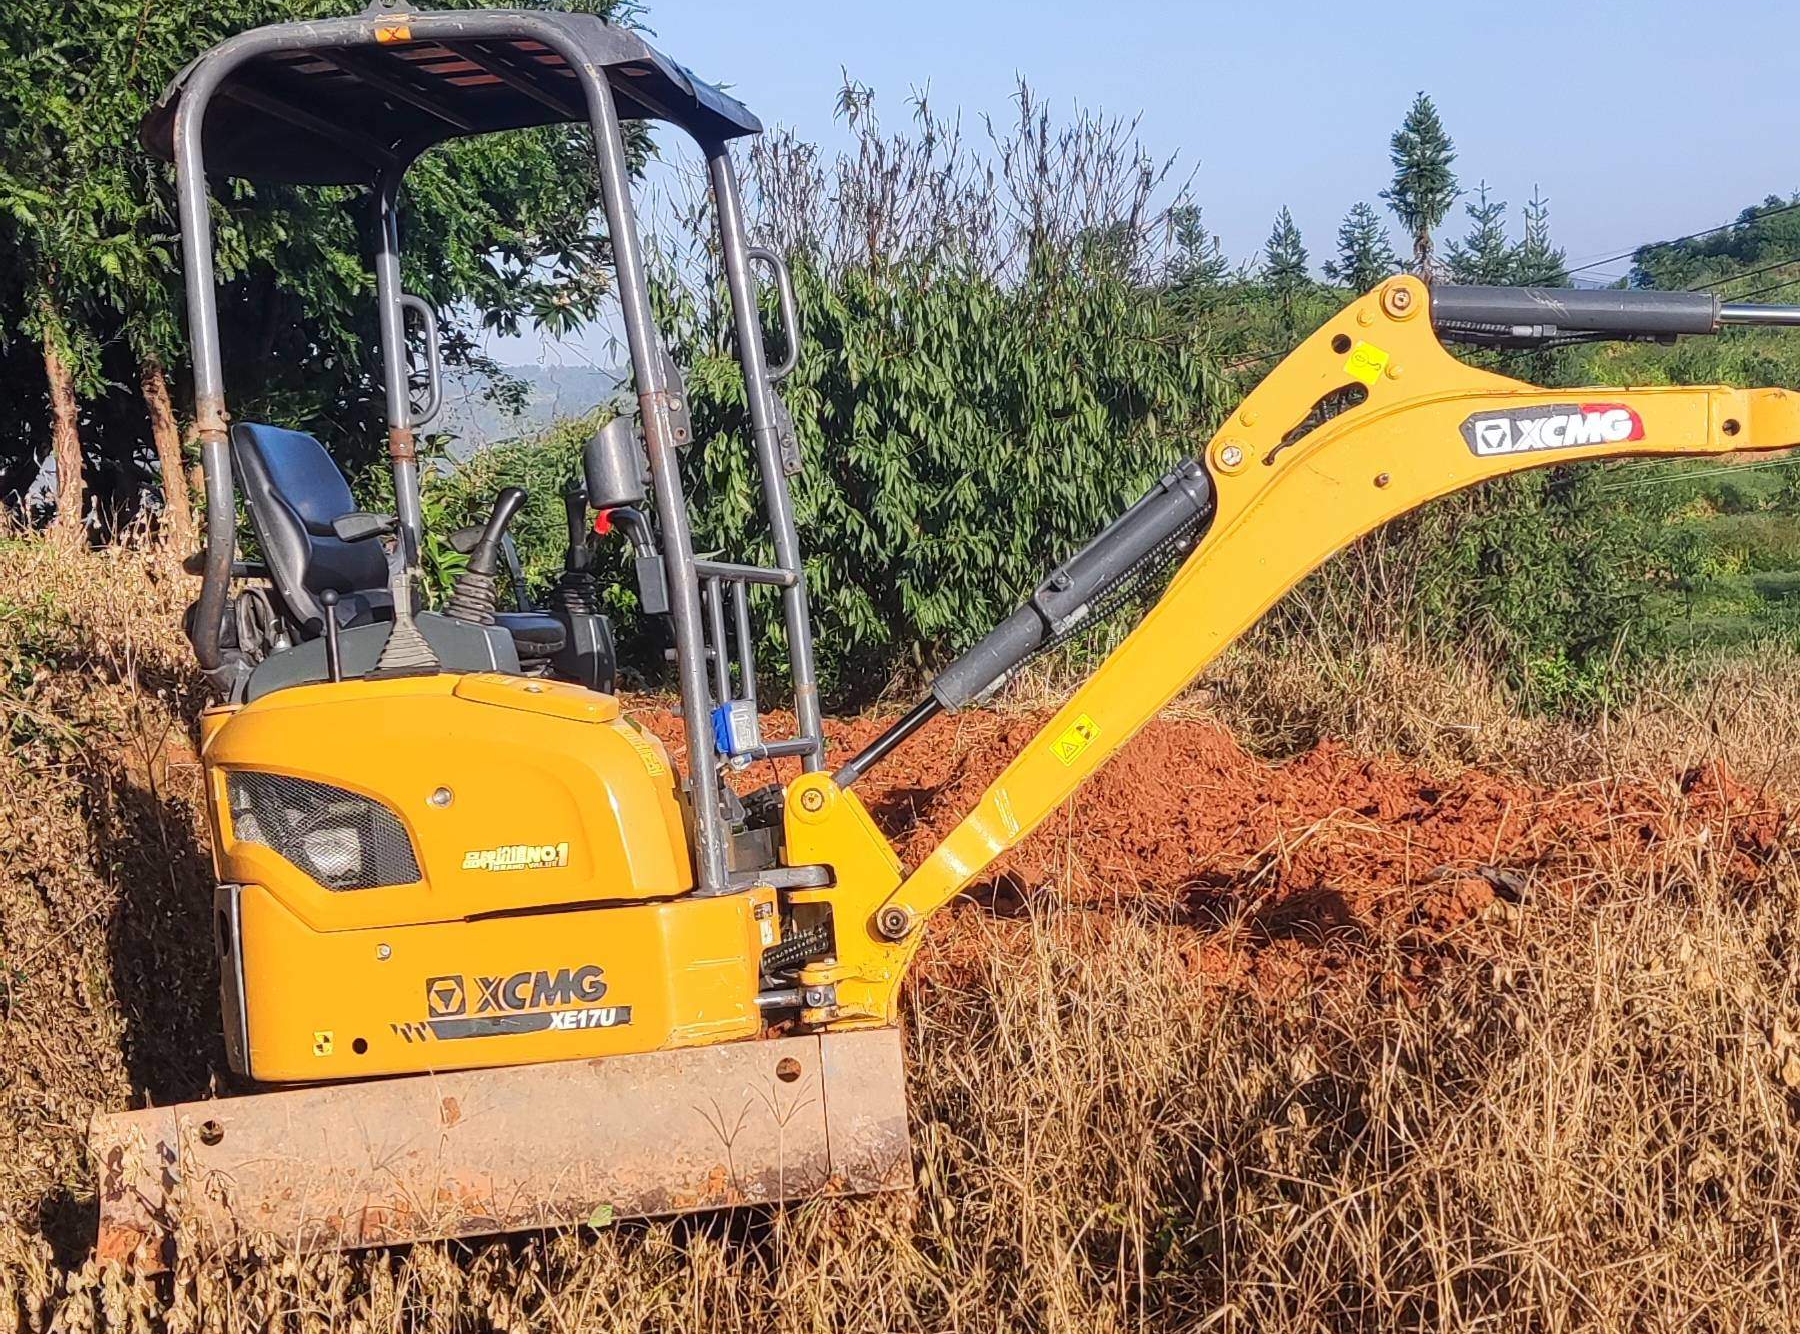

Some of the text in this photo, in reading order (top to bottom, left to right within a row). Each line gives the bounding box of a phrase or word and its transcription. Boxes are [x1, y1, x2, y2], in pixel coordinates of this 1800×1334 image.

[1512, 409, 1633, 451] XCMG
[474, 965, 607, 1014] XCMG
[549, 1007, 616, 1030] XE17U
